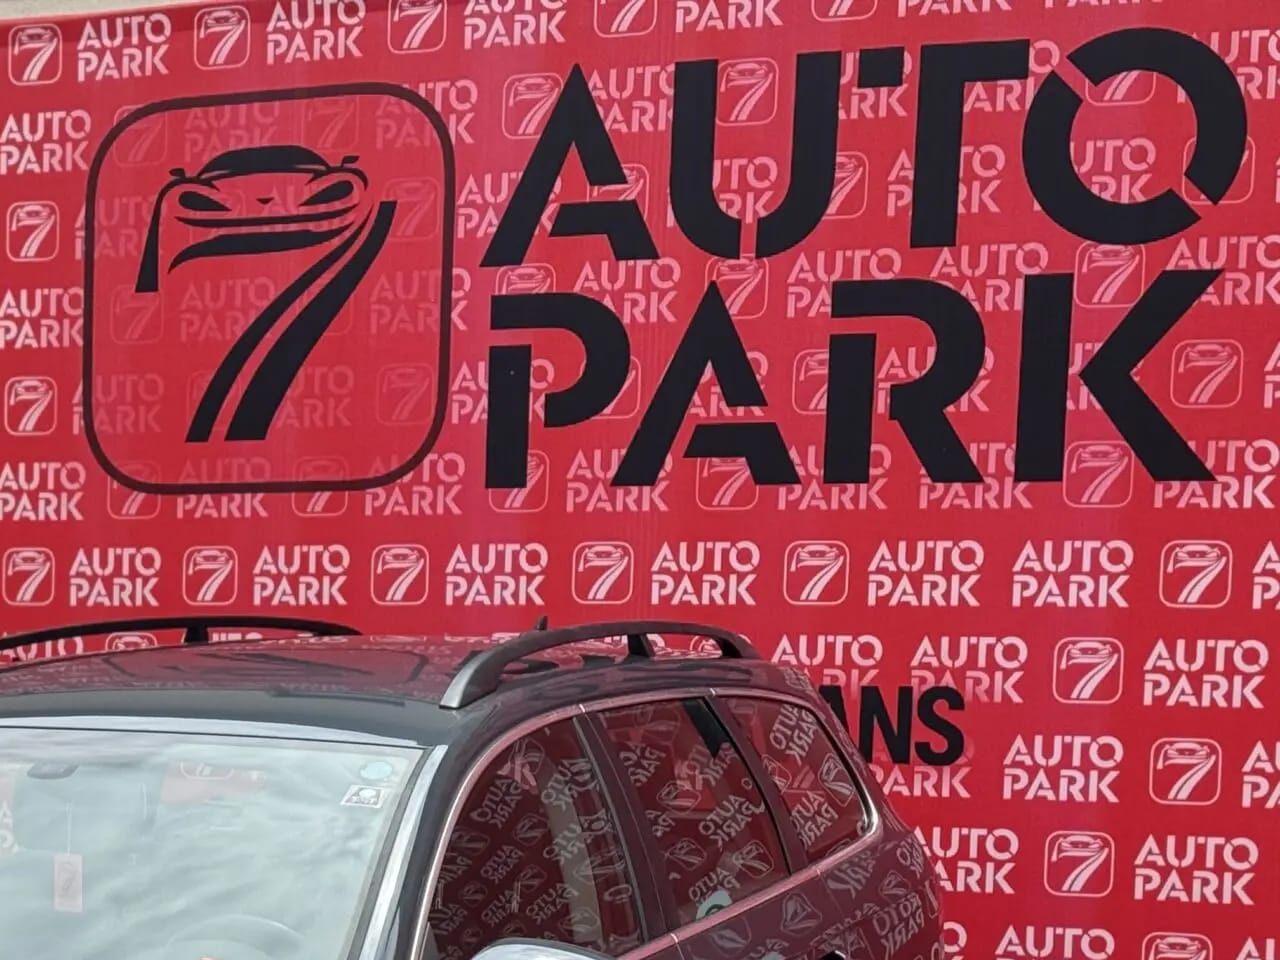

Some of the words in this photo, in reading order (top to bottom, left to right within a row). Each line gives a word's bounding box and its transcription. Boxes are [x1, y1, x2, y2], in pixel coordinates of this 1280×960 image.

[78, 15, 171, 48] AUTO
[267, 0, 365, 32] AUTO
[465, 11, 566, 49] PARK
[675, 0, 783, 32] PARK
[267, 26, 363, 64] PARK
[78, 44, 169, 82] PARK
[0, 110, 91, 143] AUTO
[0, 142, 88, 174] PARK
[480, 27, 1247, 267] AUTO
[574, 258, 681, 291] AUTO
[787, 248, 901, 283] AUTO
[930, 242, 1048, 277] AUTO
[485, 269, 1220, 489] PARK
[177, 490, 269, 518] PARK
[364, 484, 463, 516] PARK
[566, 481, 670, 512] PARK
[777, 478, 888, 510] PARK
[919, 478, 1033, 509] PARK
[1154, 475, 1276, 508] PARK
[70, 547, 161, 576] AUTO
[253, 544, 350, 574] AUTO
[446, 543, 548, 573] AUTO
[651, 541, 760, 572] AUTO
[868, 540, 984, 572] AUTO
[1013, 540, 1133, 573] AUTO
[70, 577, 158, 606] PARK
[254, 576, 347, 605] PARK
[446, 575, 544, 605] PARK
[651, 574, 756, 605] PARK
[868, 574, 980, 606] PARK
[1012, 574, 1129, 607] PARK
[771, 634, 883, 666] AUTO
[910, 635, 1028, 669] AUTO
[1144, 639, 1268, 673] AUTO
[1144, 673, 1264, 708] PARK
[1004, 735, 1123, 768] AUTO
[1003, 768, 1119, 802] PARK
[1135, 834, 1258, 870] AUTO
[934, 861, 1016, 894] ARK
[1135, 868, 1254, 905] PARK
[995, 926, 1115, 960] AUTO
